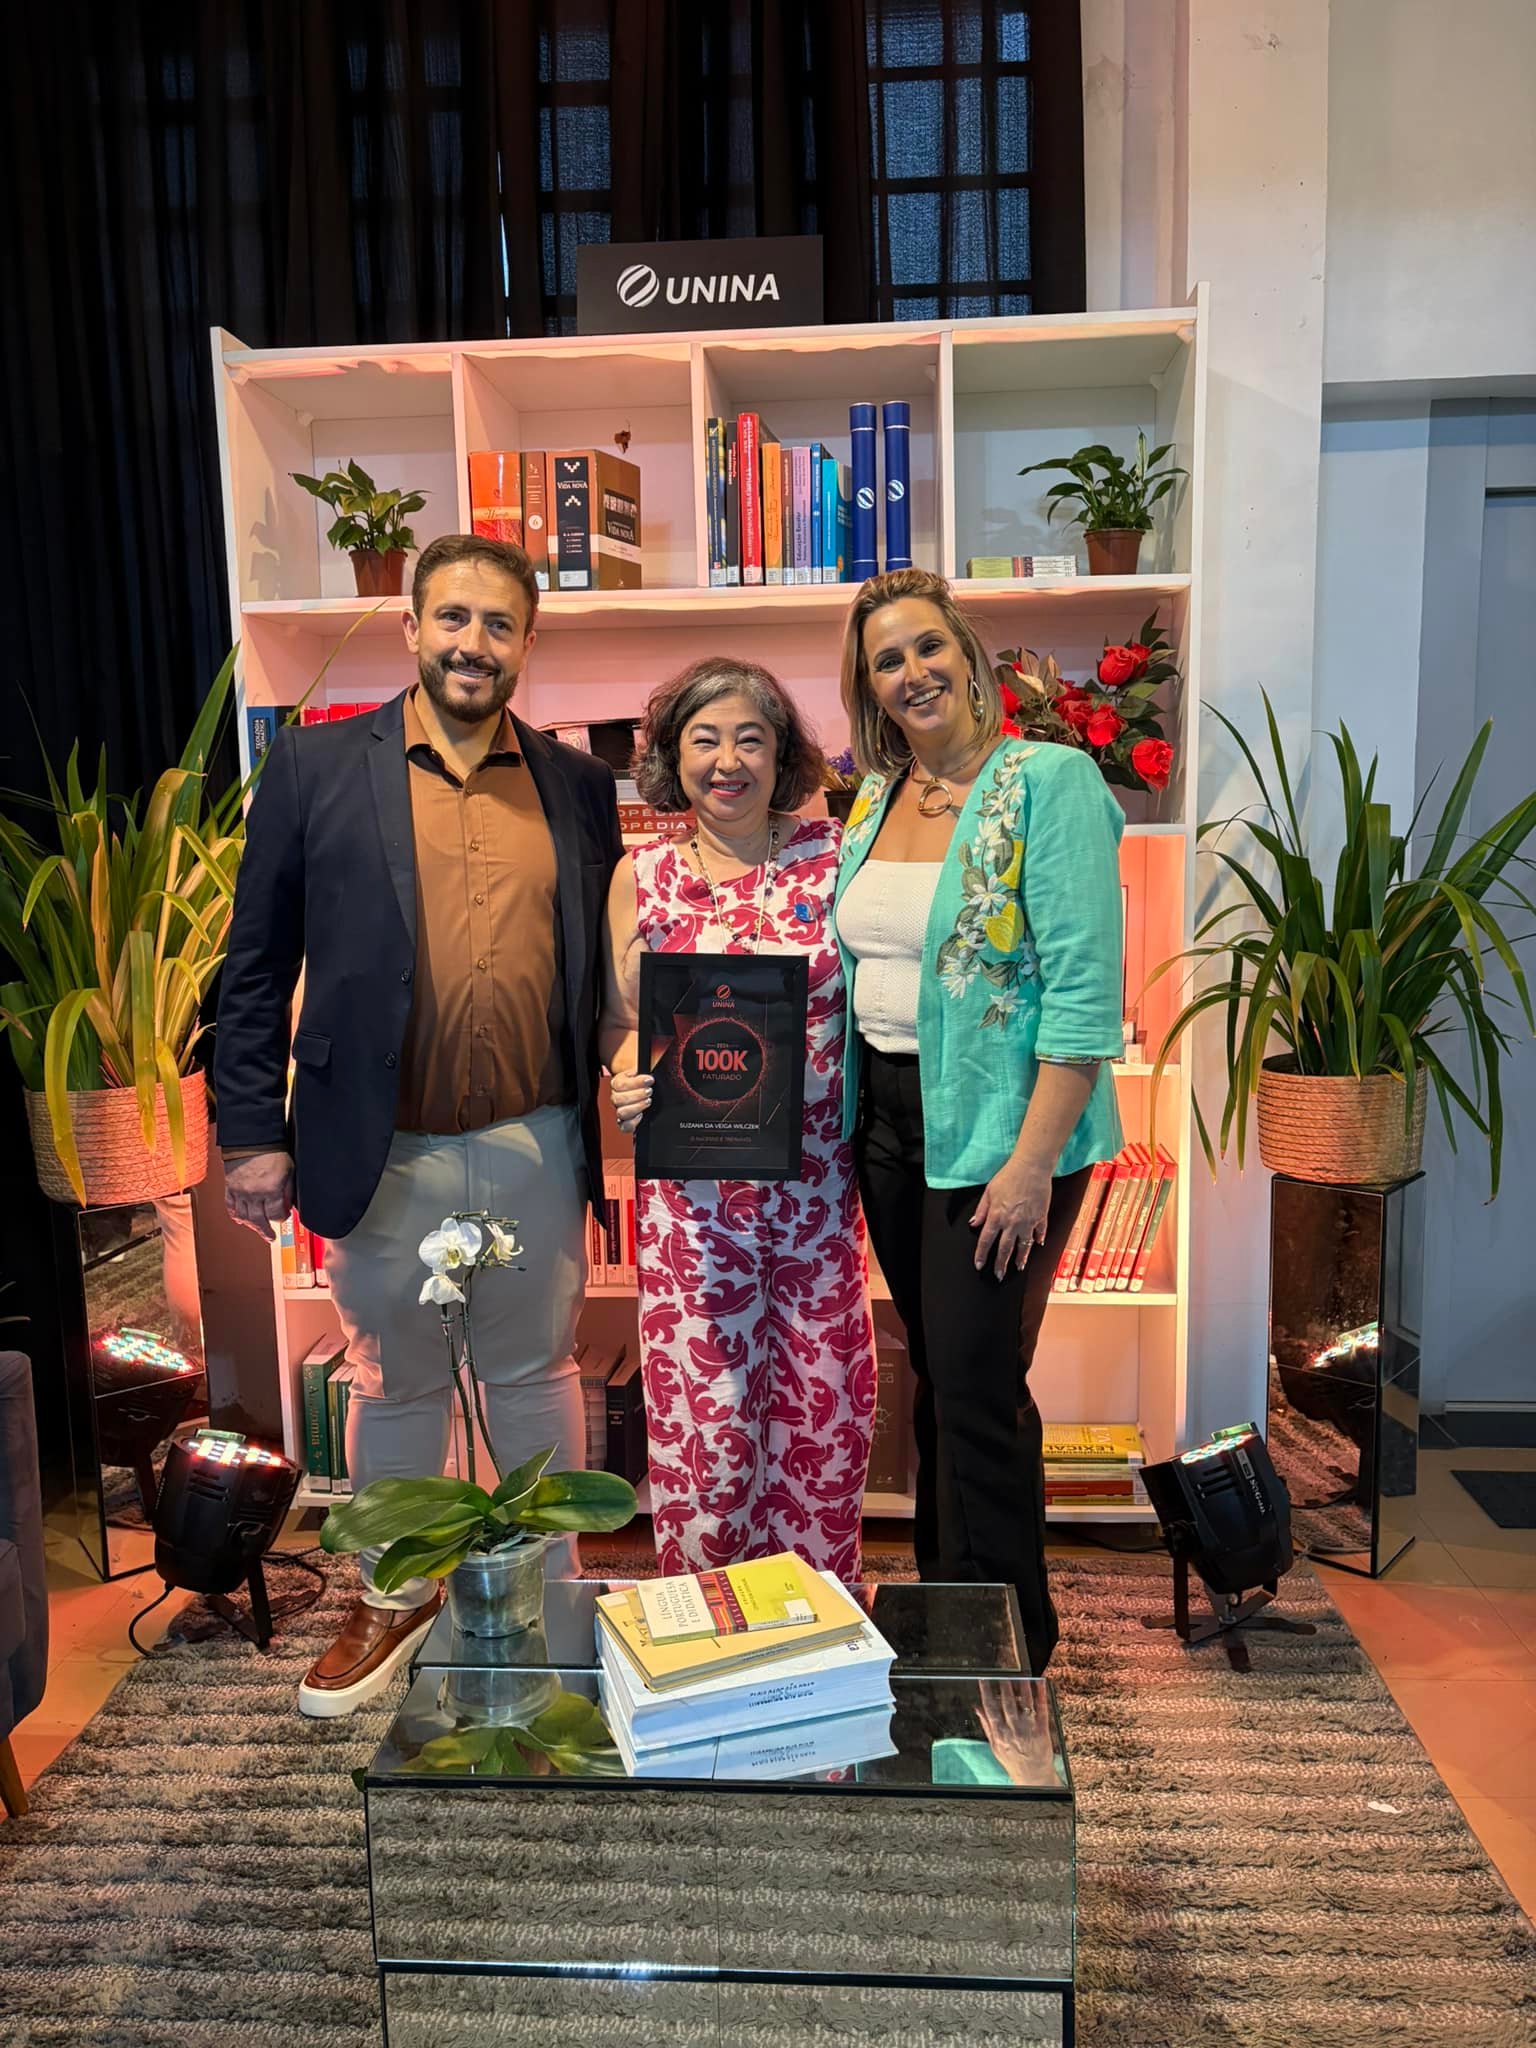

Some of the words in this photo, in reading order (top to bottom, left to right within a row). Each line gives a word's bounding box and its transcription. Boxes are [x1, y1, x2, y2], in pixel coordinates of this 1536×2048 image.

[666, 273, 780, 304] UNINA
[712, 1001, 735, 1009] UNINA
[696, 1049, 748, 1072] 100K
[702, 1073, 742, 1081] FATURADO
[656, 1591, 673, 1620] LÍNGUA
[665, 1581, 688, 1627] PORTUGUESA
[678, 1582, 698, 1618] DIDÁTICA
